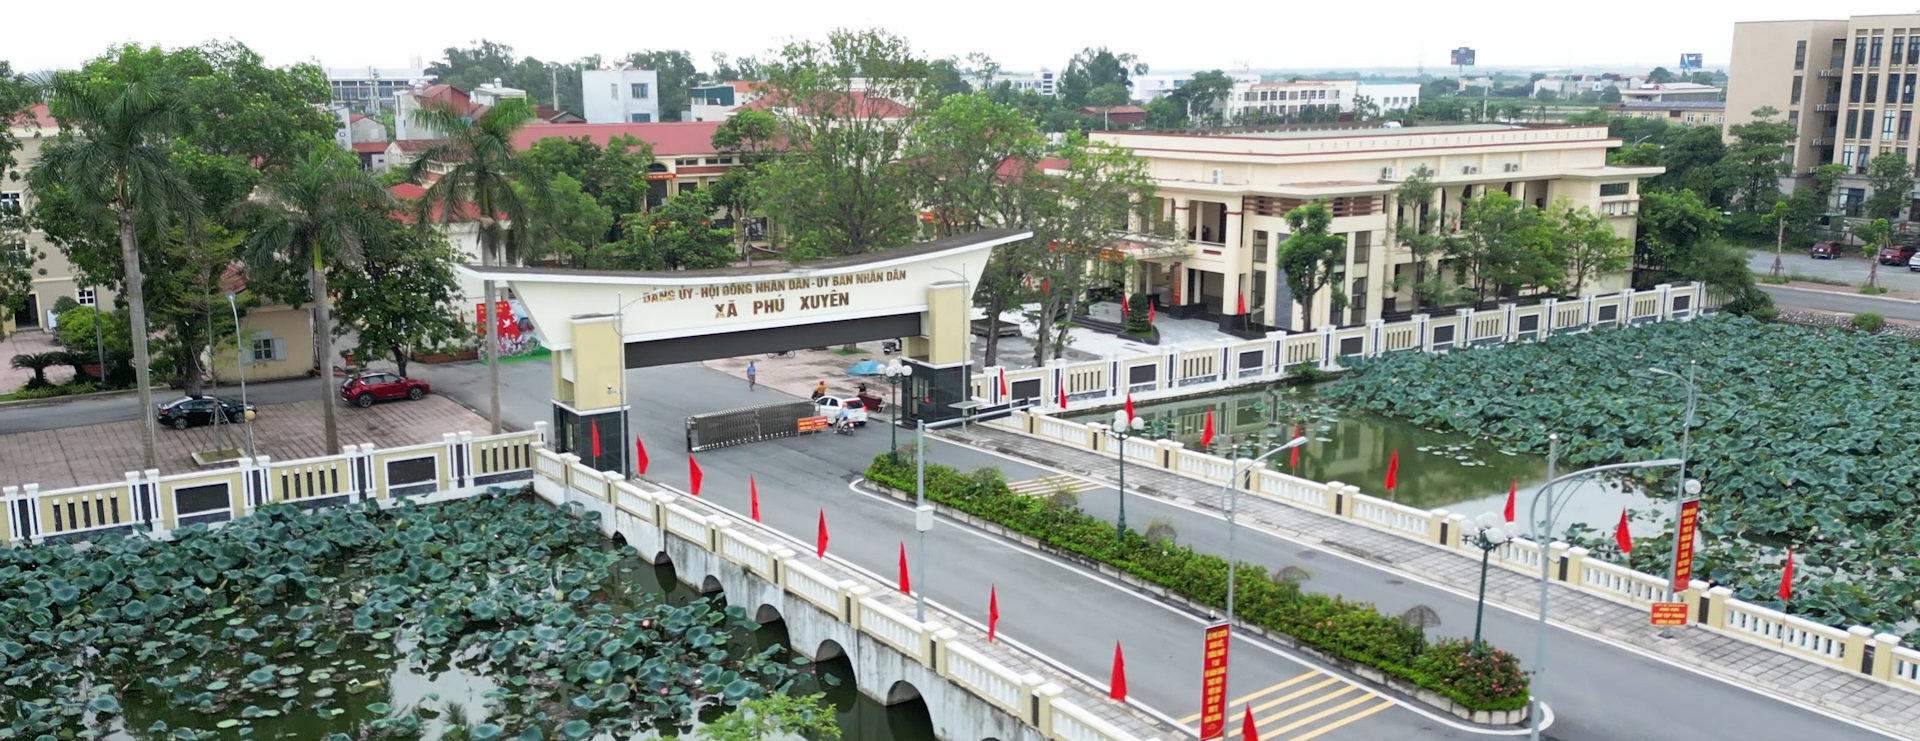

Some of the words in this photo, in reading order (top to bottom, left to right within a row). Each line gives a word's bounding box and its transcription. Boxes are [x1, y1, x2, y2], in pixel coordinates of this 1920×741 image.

[701, 284, 720, 300] HỘI
[833, 274, 853, 287] BAN
[856, 271, 884, 285] NHÂN
[887, 268, 907, 282] DÂN
[715, 300, 738, 319] XÃ
[753, 294, 785, 315] PHÚ
[800, 289, 850, 311] XUYÊN
